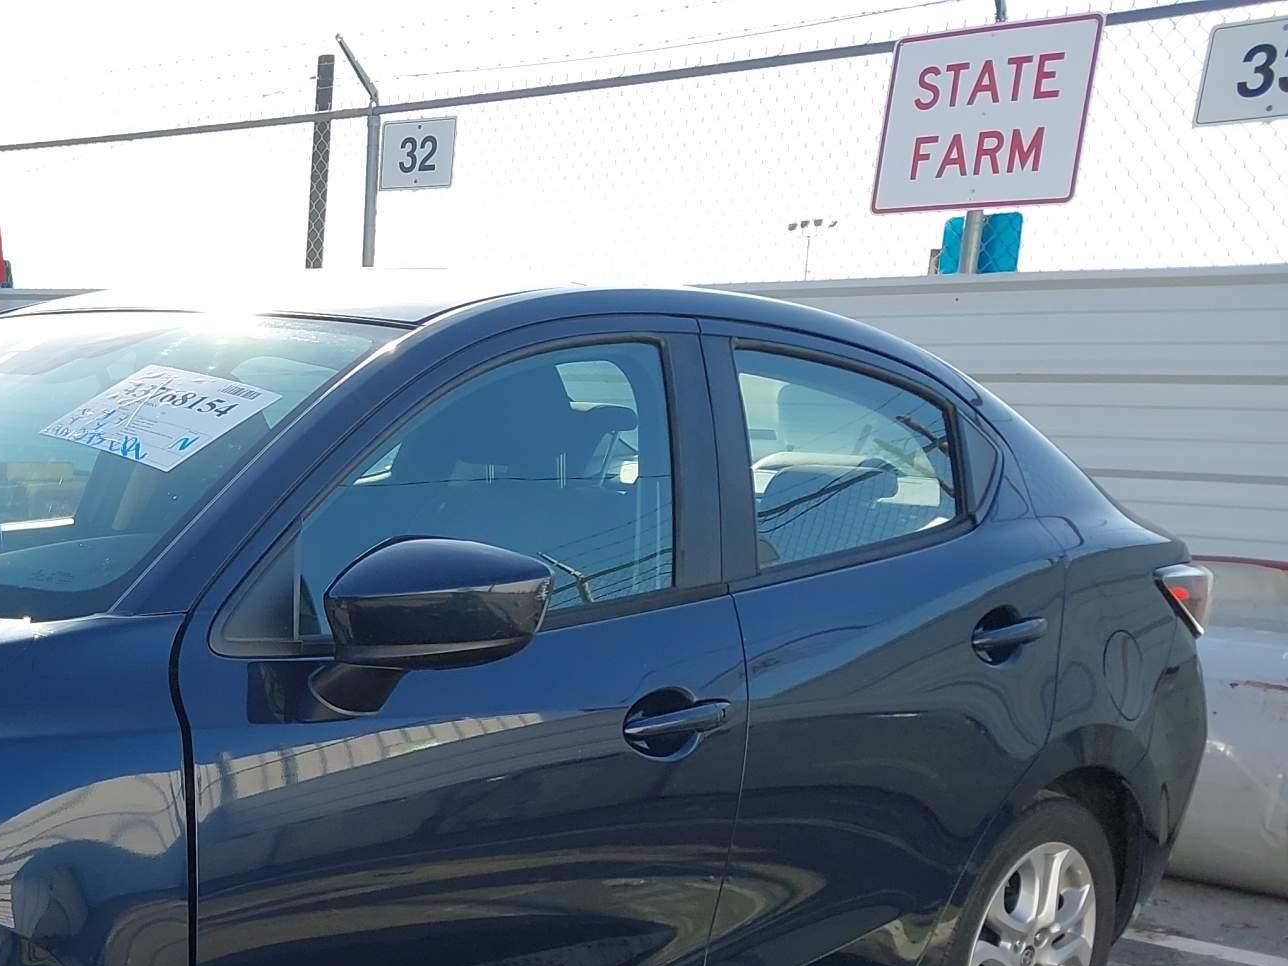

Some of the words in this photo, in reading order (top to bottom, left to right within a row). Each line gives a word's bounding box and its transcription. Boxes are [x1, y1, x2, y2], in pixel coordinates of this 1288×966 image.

[914, 52, 1065, 111] STATE
[1237, 44, 1288, 97] 3
[399, 136, 438, 173] 32
[909, 127, 1045, 180] FARM
